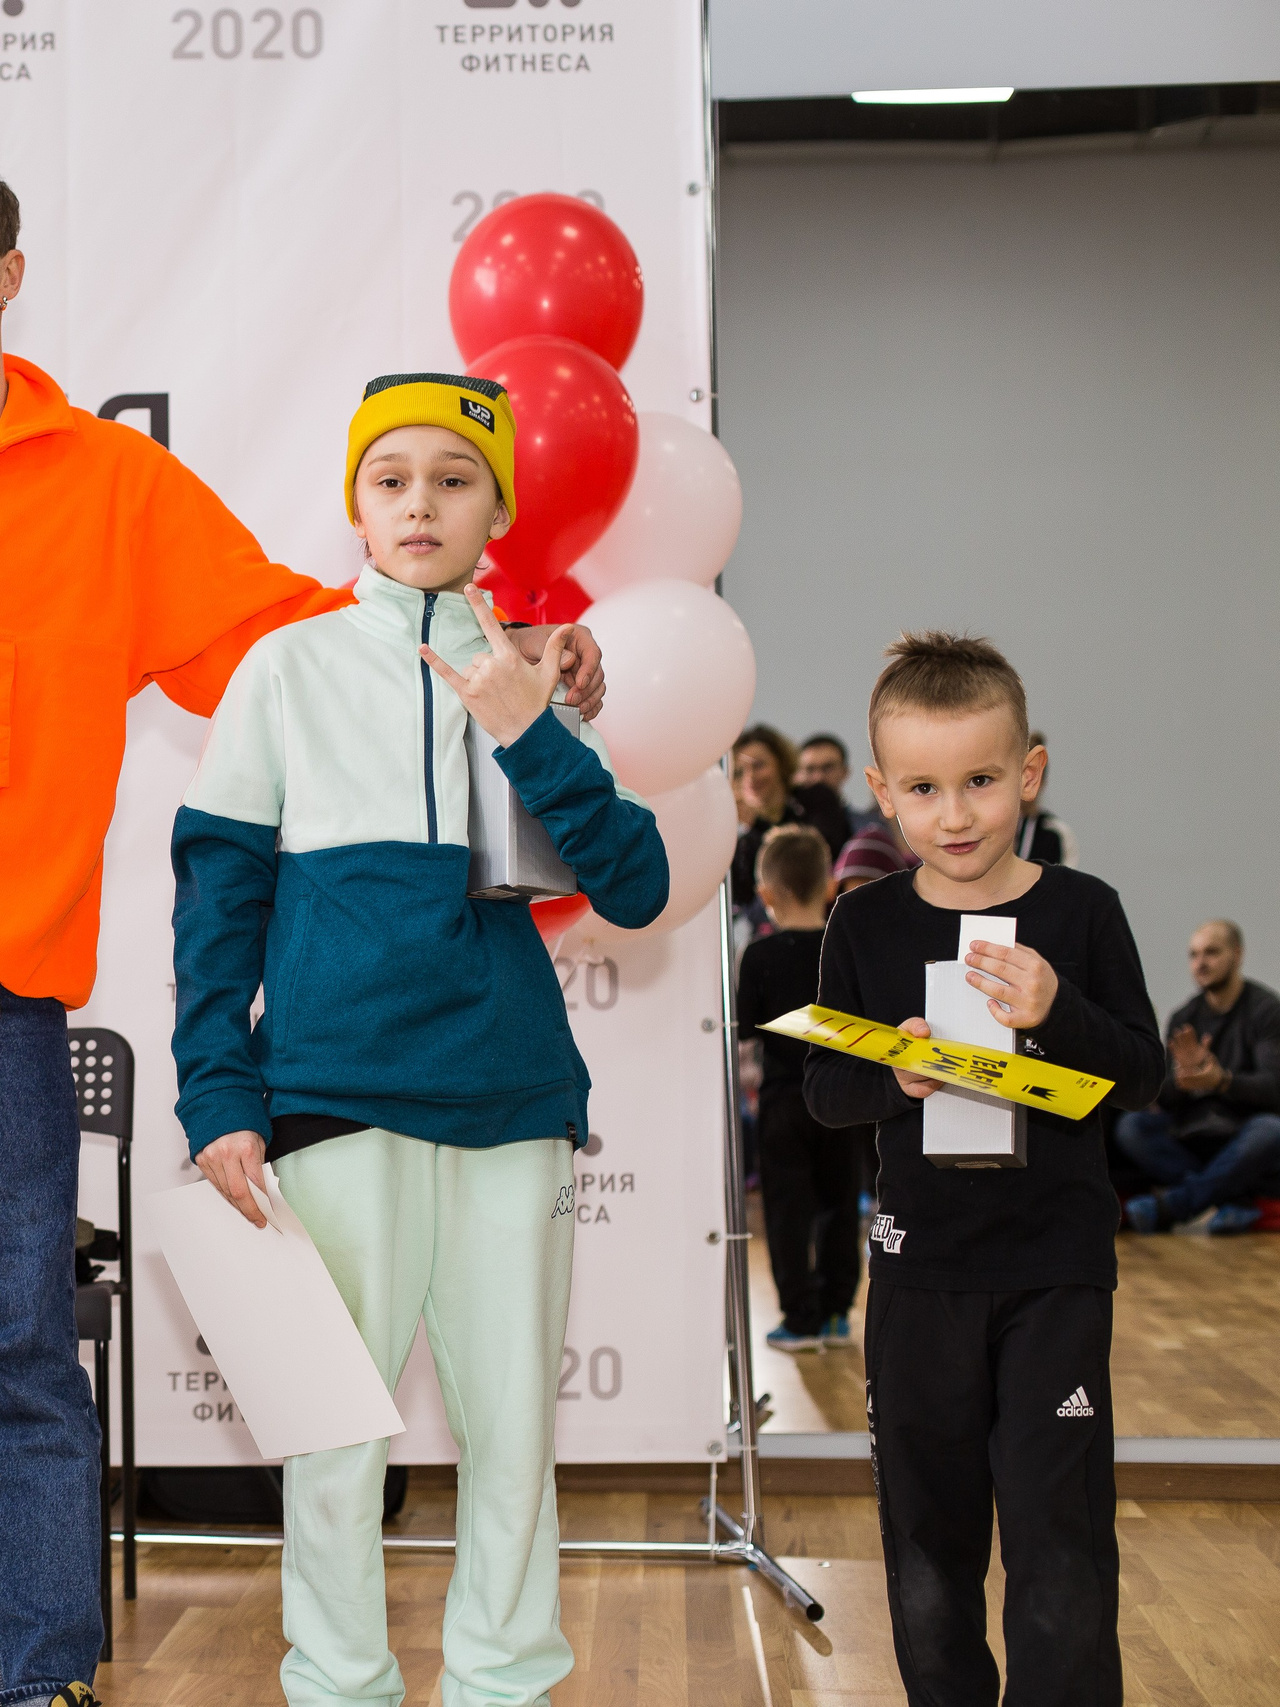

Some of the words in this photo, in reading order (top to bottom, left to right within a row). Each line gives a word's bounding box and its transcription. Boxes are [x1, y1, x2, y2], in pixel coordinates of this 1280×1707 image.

[171, 8, 323, 60] 2020
[435, 23, 616, 43] ТЕРРИТОРИЯ
[460, 53, 591, 73] ФИТНЕСА
[1056, 1405, 1094, 1417] adidas
